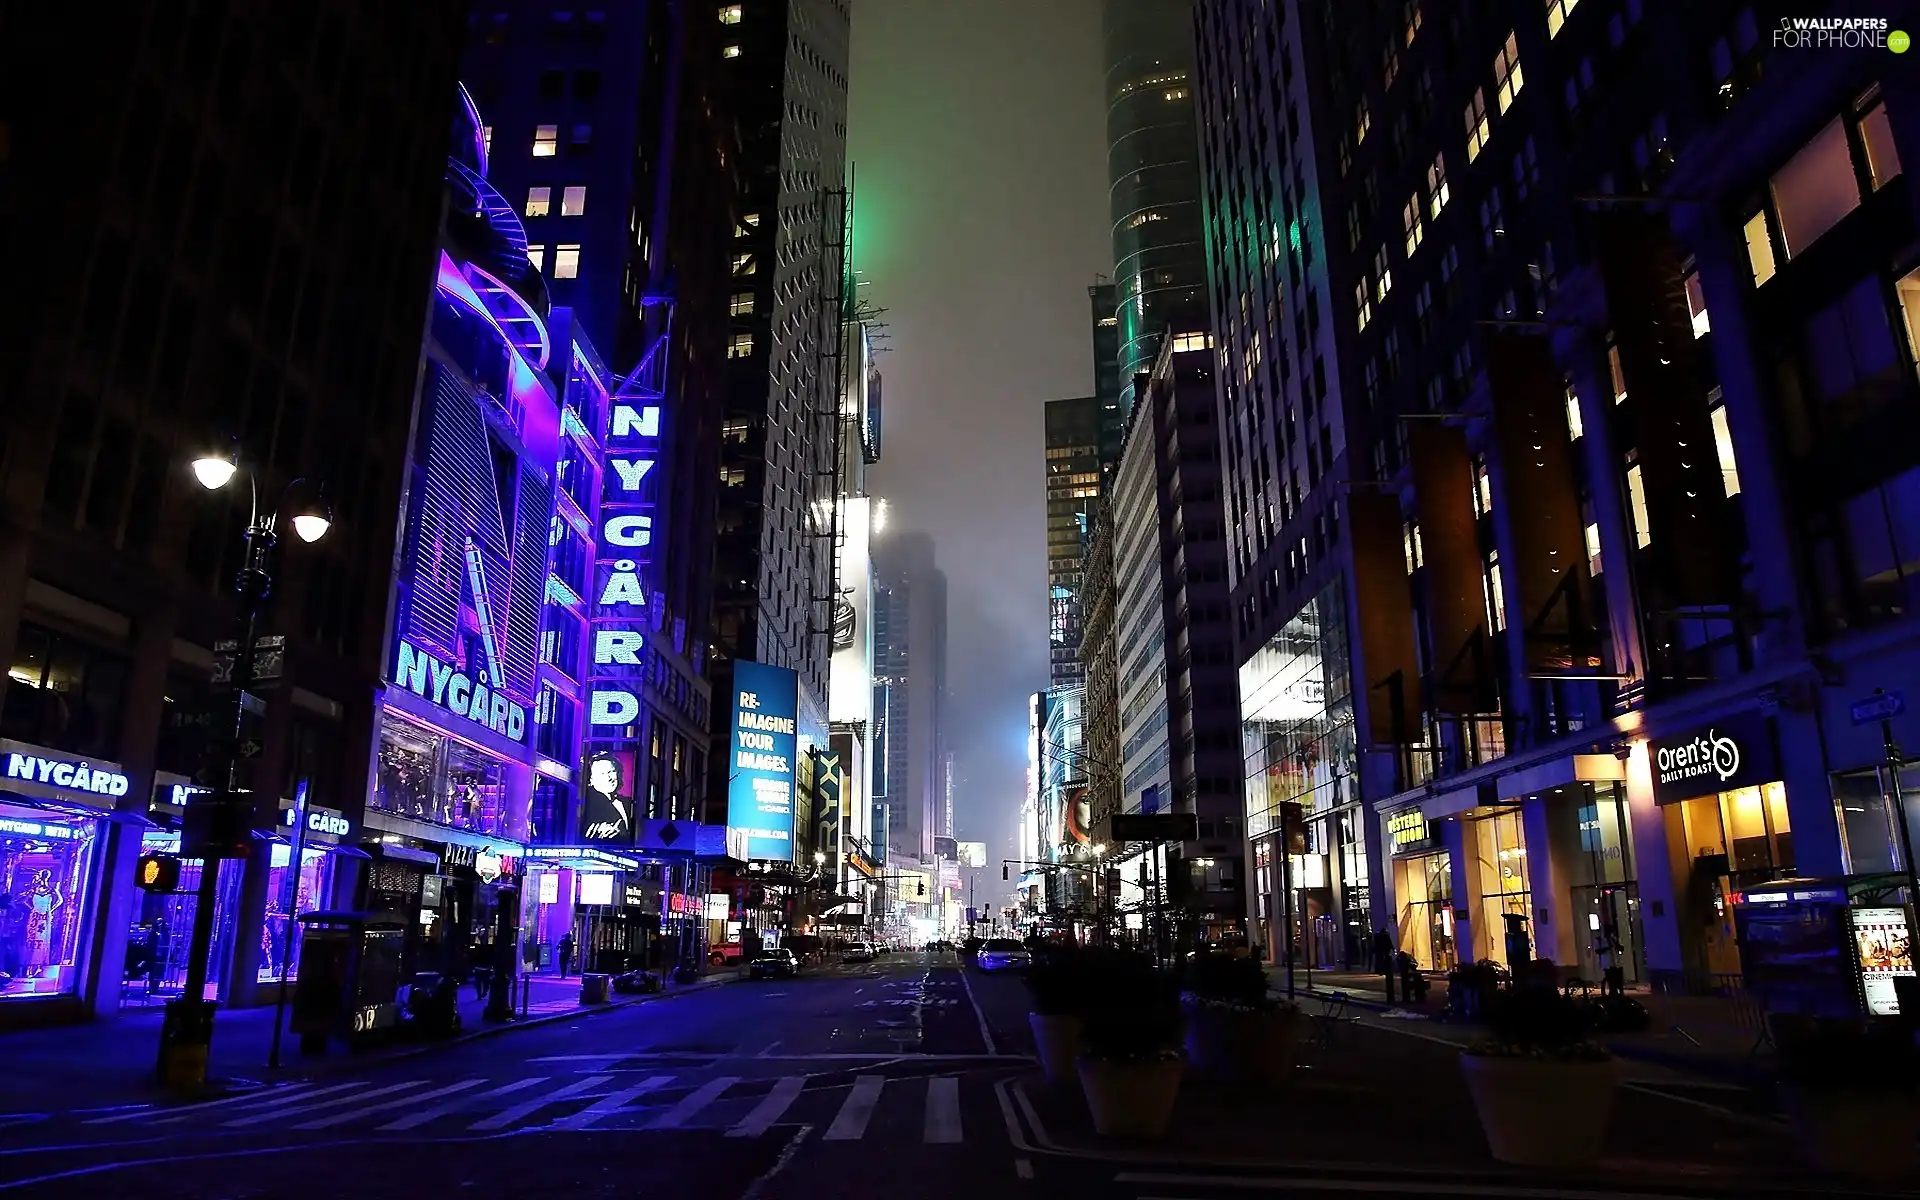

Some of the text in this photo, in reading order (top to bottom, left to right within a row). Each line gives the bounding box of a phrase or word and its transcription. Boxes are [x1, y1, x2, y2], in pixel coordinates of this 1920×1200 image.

[591, 405, 660, 726] NYGÅRD
[395, 640, 525, 742] NYGÅRD
[739, 691, 761, 710] RE-
[738, 711, 795, 735] IMAGINE
[737, 730, 775, 752] YOUR
[736, 750, 790, 774] IMAGES.
[1658, 737, 1711, 771] Oren's
[7, 752, 129, 797] NYGÅRD
[1660, 761, 1712, 784] DAILY ROAST
[1387, 811, 1423, 834] WESTERN
[1395, 826, 1425, 845] UNION
[444, 842, 474, 867] PIZZA
